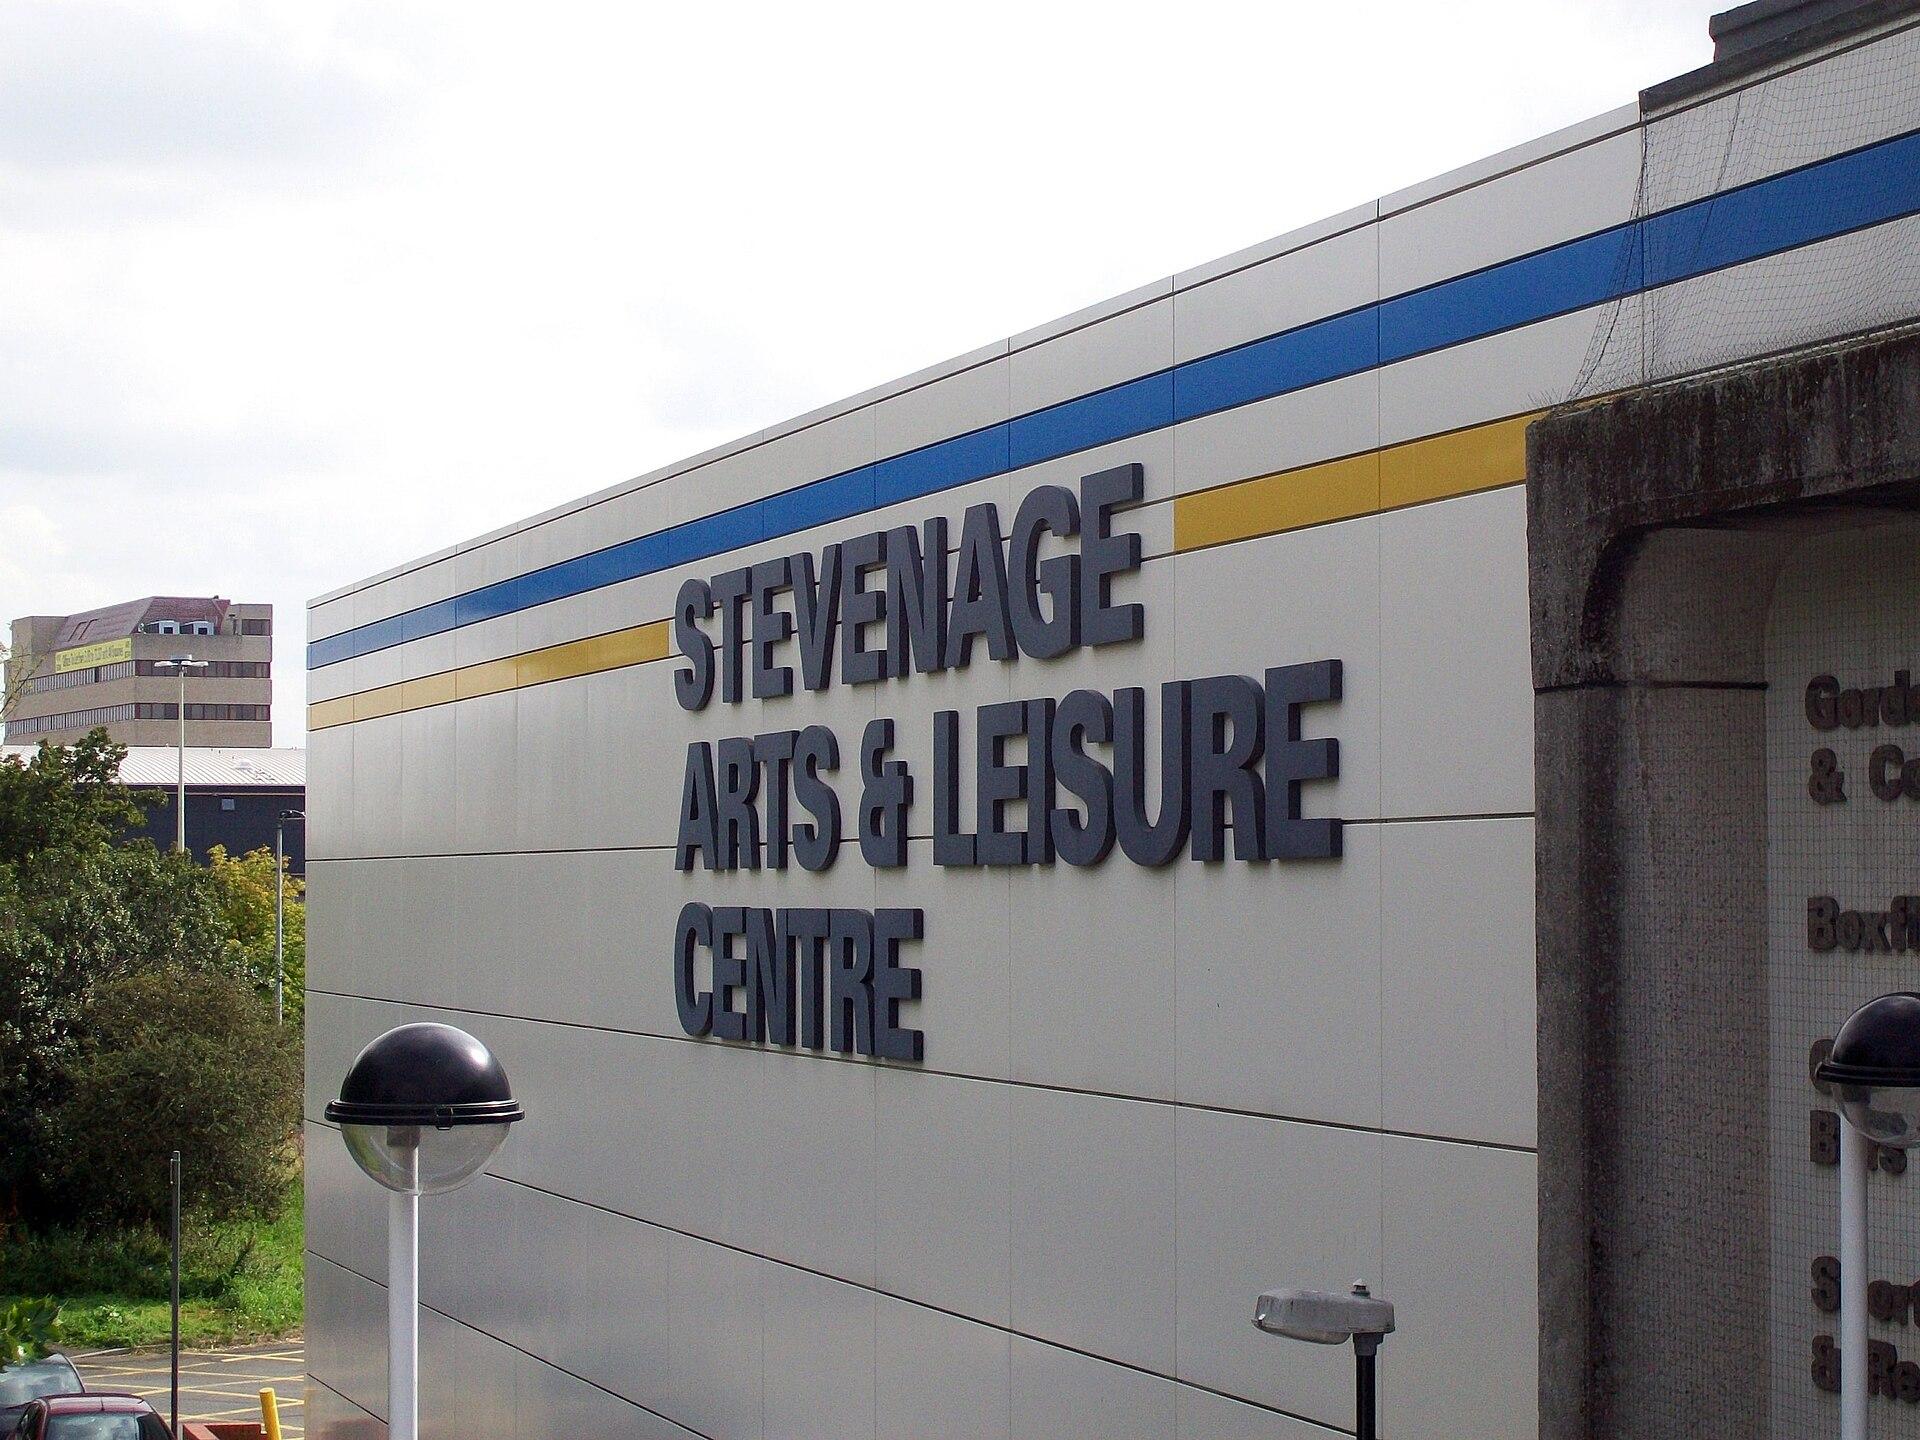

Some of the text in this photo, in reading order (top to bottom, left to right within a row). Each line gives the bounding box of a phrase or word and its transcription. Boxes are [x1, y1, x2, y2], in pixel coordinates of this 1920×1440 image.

[673, 462, 1143, 711] STEVENAGE
[674, 659, 1342, 871] ARTS & LEISURE
[1808, 747, 1847, 804] &
[673, 902, 924, 1062] CENTRE
